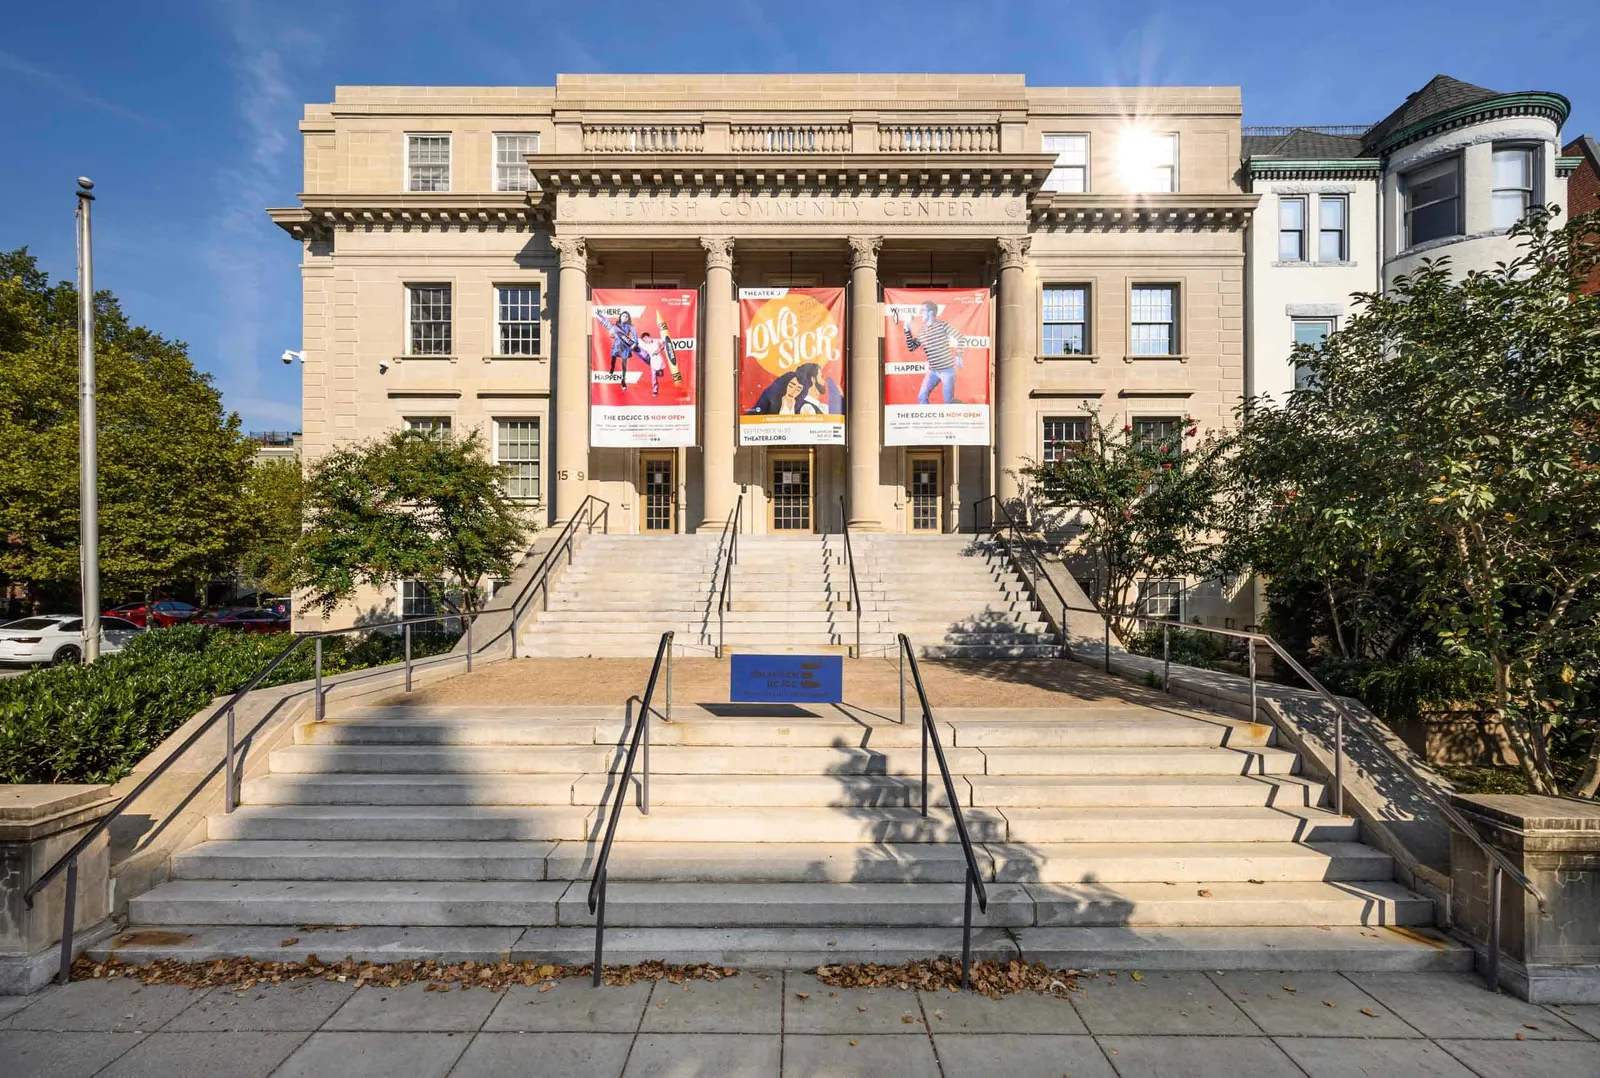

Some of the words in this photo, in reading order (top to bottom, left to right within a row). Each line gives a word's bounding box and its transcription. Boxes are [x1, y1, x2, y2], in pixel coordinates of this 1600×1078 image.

[609, 201, 698, 217] JEWISH
[719, 201, 864, 217] COMMUNITY
[883, 201, 974, 217] CENTER
[595, 308, 622, 316] WHERE
[890, 307, 917, 315] WHERE
[745, 306, 798, 360] LOVE
[672, 340, 694, 349] YOU
[778, 323, 841, 369] SICK
[964, 338, 987, 347] YOU
[894, 364, 925, 372] HAPPEN
[594, 373, 622, 381] HAPPEN
[557, 470, 585, 481] 159
